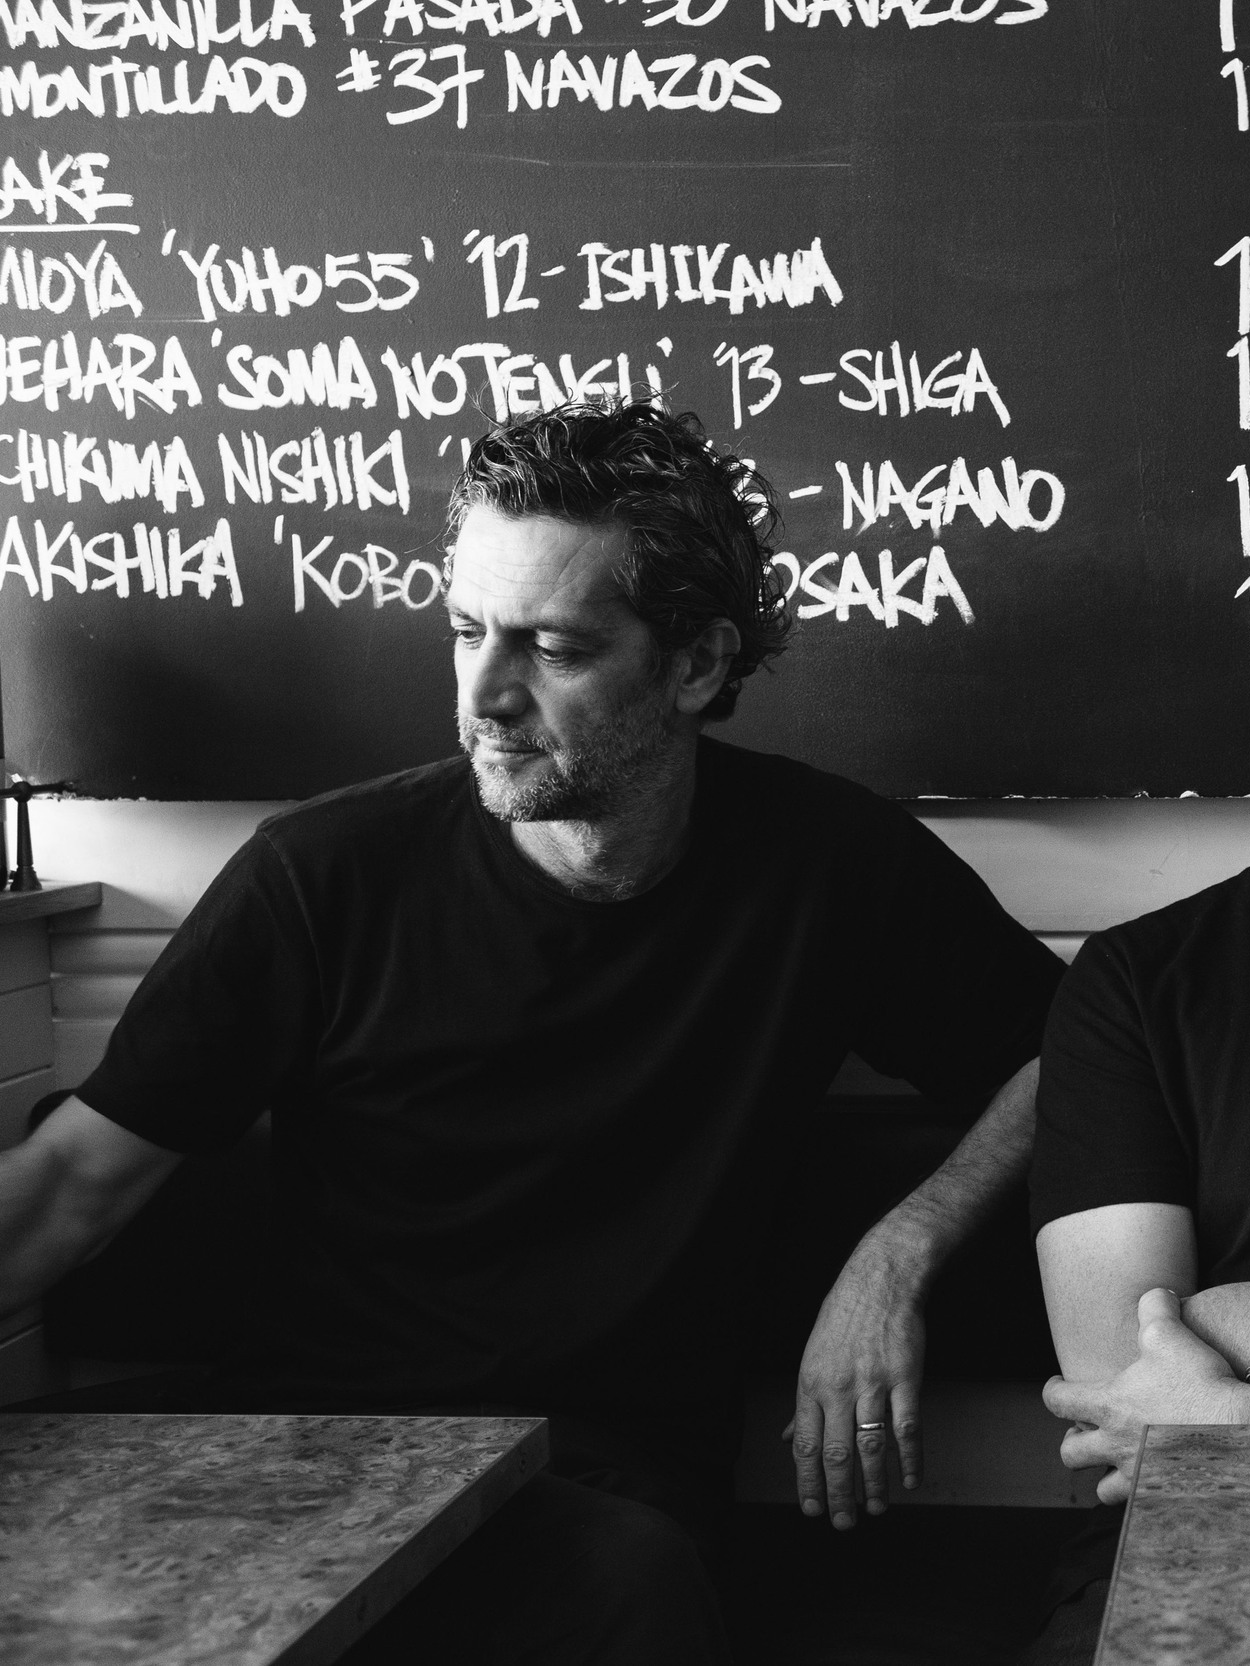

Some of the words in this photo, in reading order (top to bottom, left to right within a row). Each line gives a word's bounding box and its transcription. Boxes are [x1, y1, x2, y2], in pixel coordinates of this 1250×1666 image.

[0, 0, 316, 54] ANZANILLA
[336, 44, 484, 129] #37
[504, 49, 782, 113] NAVAZOS
[463, 229, 539, 318] '12
[577, 237, 843, 314] ISHIKAWA
[0, 330, 202, 420] EHARA
[713, 342, 781, 429] '13
[839, 341, 1010, 428] SHIGA
[218, 427, 410, 515] NISHIKI
[835, 456, 1065, 535] NAGANO
[0, 515, 243, 606] AKISHIKA
